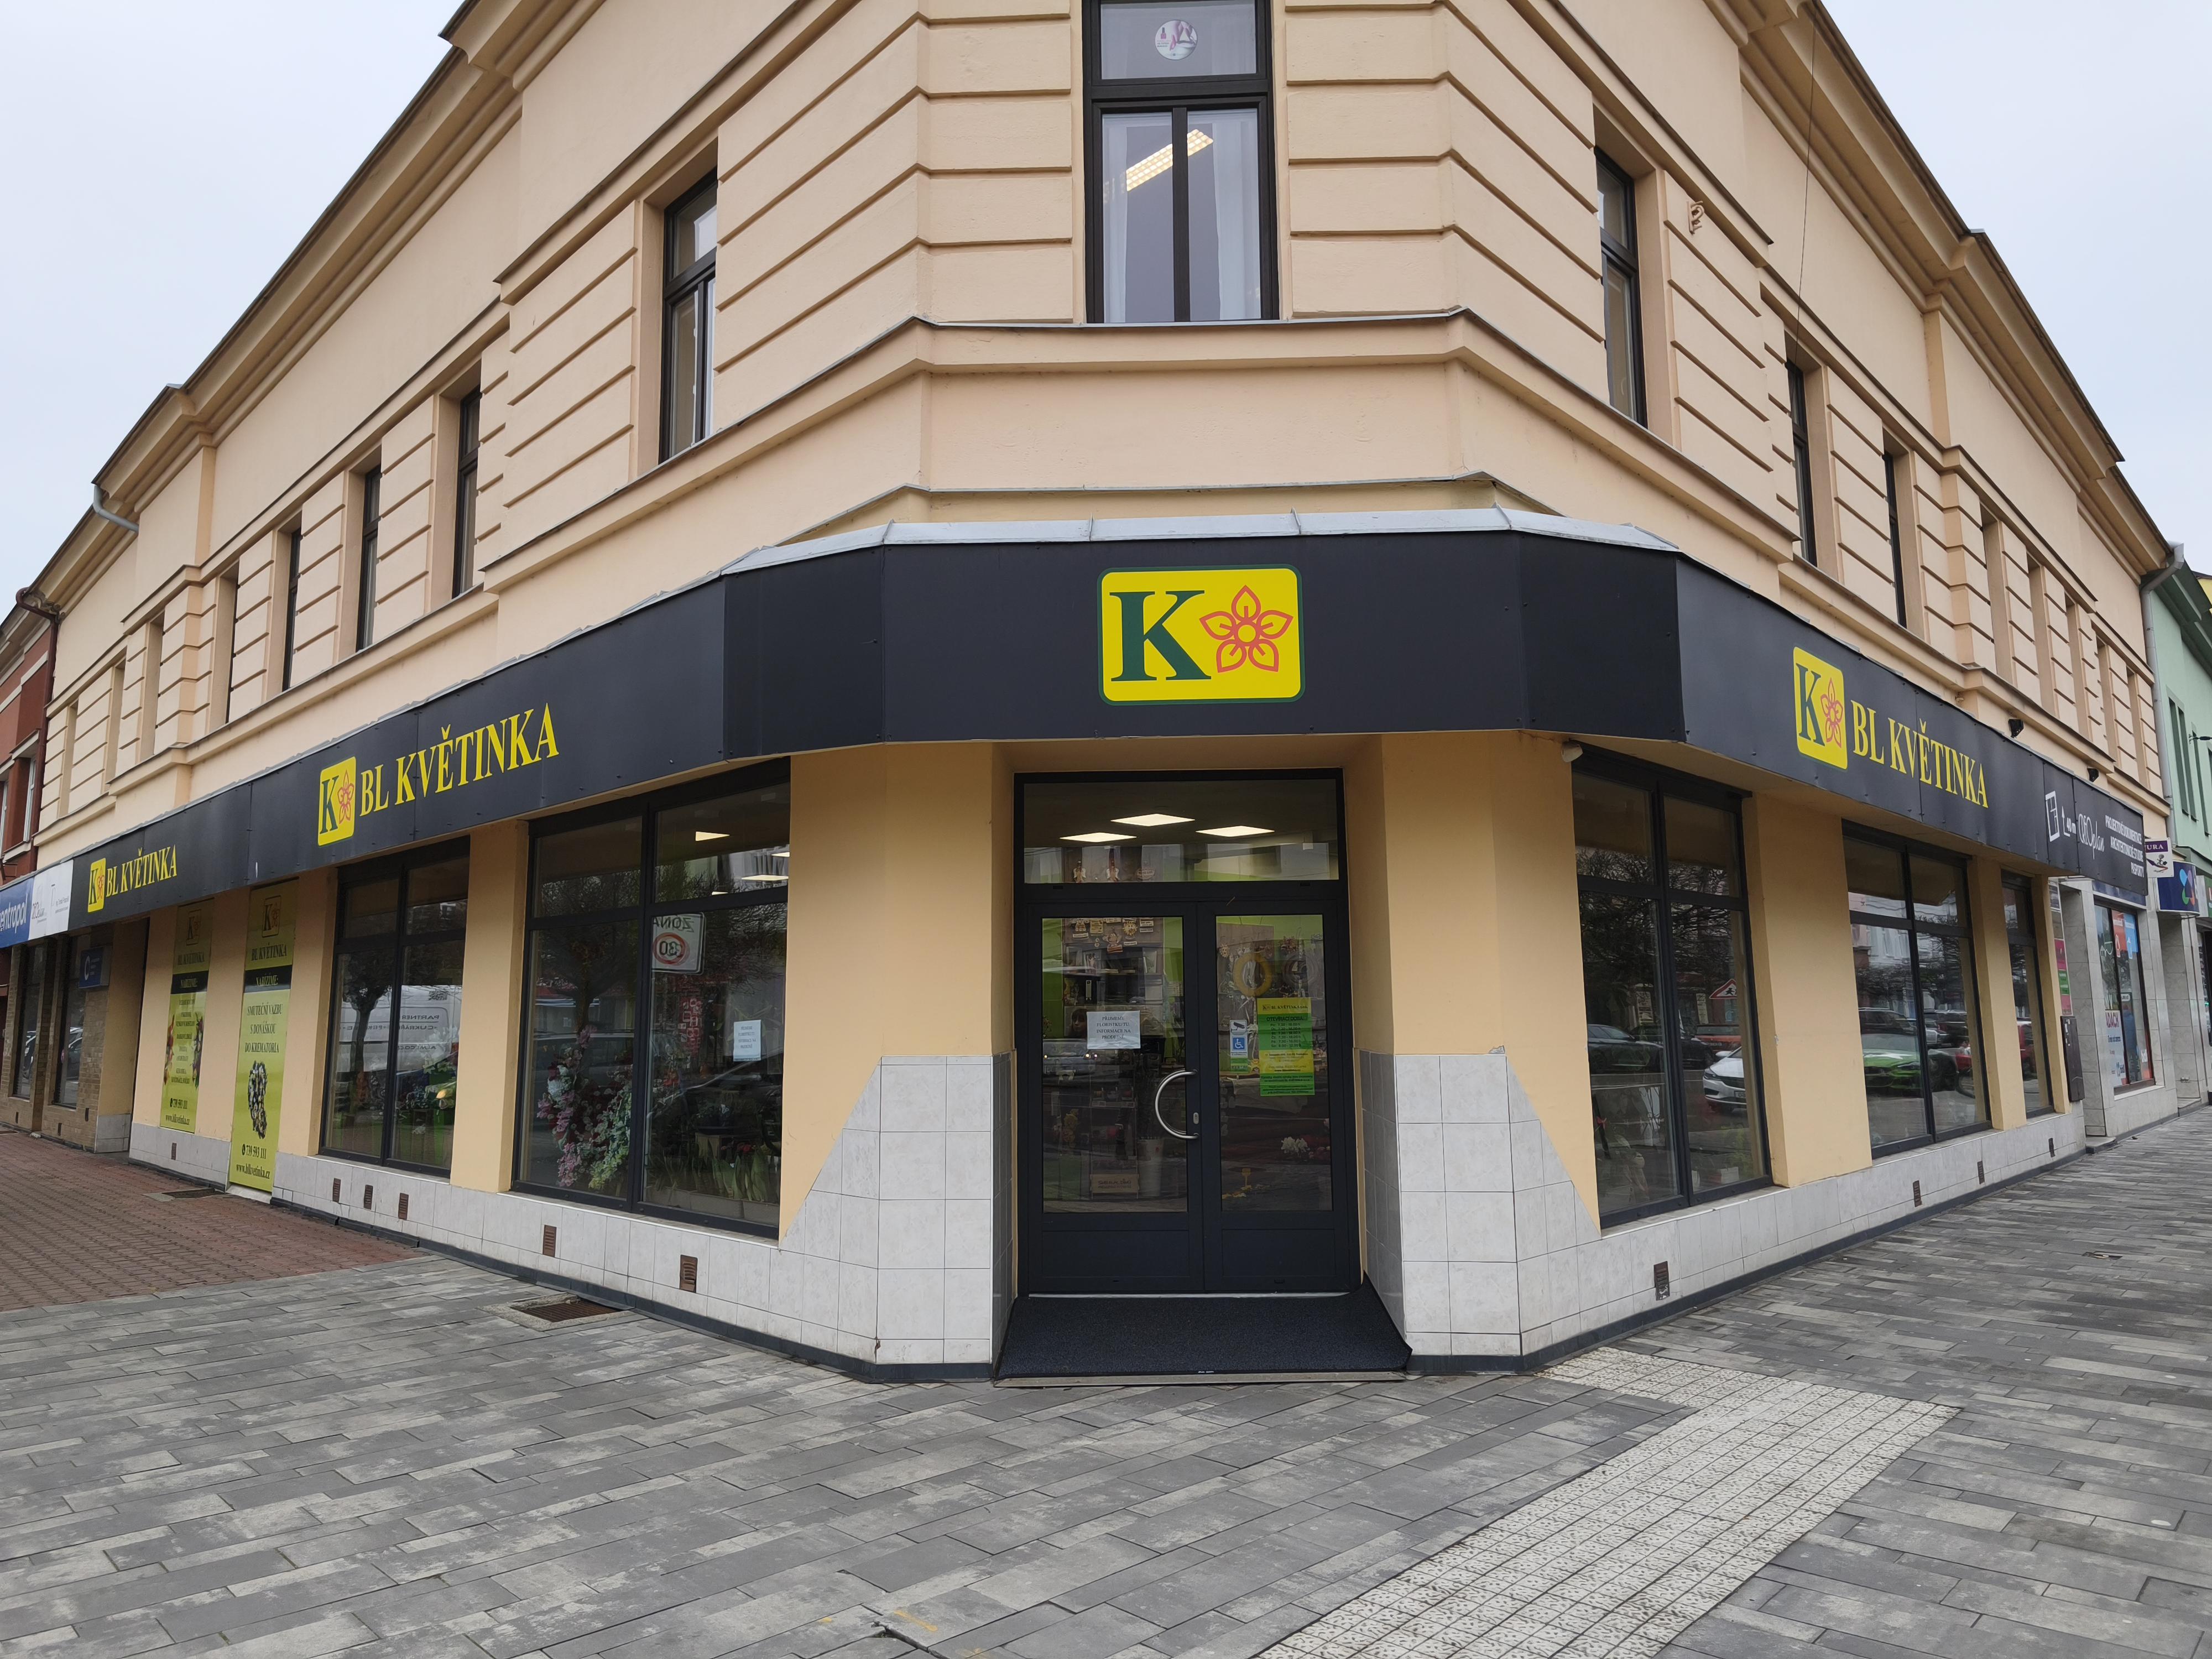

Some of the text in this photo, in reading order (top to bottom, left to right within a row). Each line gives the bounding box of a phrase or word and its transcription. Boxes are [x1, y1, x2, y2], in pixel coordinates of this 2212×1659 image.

[1109, 590, 1212, 681] K
[1796, 663, 1825, 747] K
[359, 702, 560, 817] BL KVĚTINKA
[1851, 700, 1989, 808] BL KVĚTINKA
[320, 775, 339, 834] K
[2067, 817, 2072, 832] 40
[88, 869, 99, 905] K
[106, 844, 178, 898] BL KVĚTINKA
[263, 904, 273, 931] K
[251, 943, 287, 961] BL KVĚTINKA
[247, 1002, 268, 1015] SMUTEČNÍ
[245, 1042, 279, 1053] DO KREMATORIA
